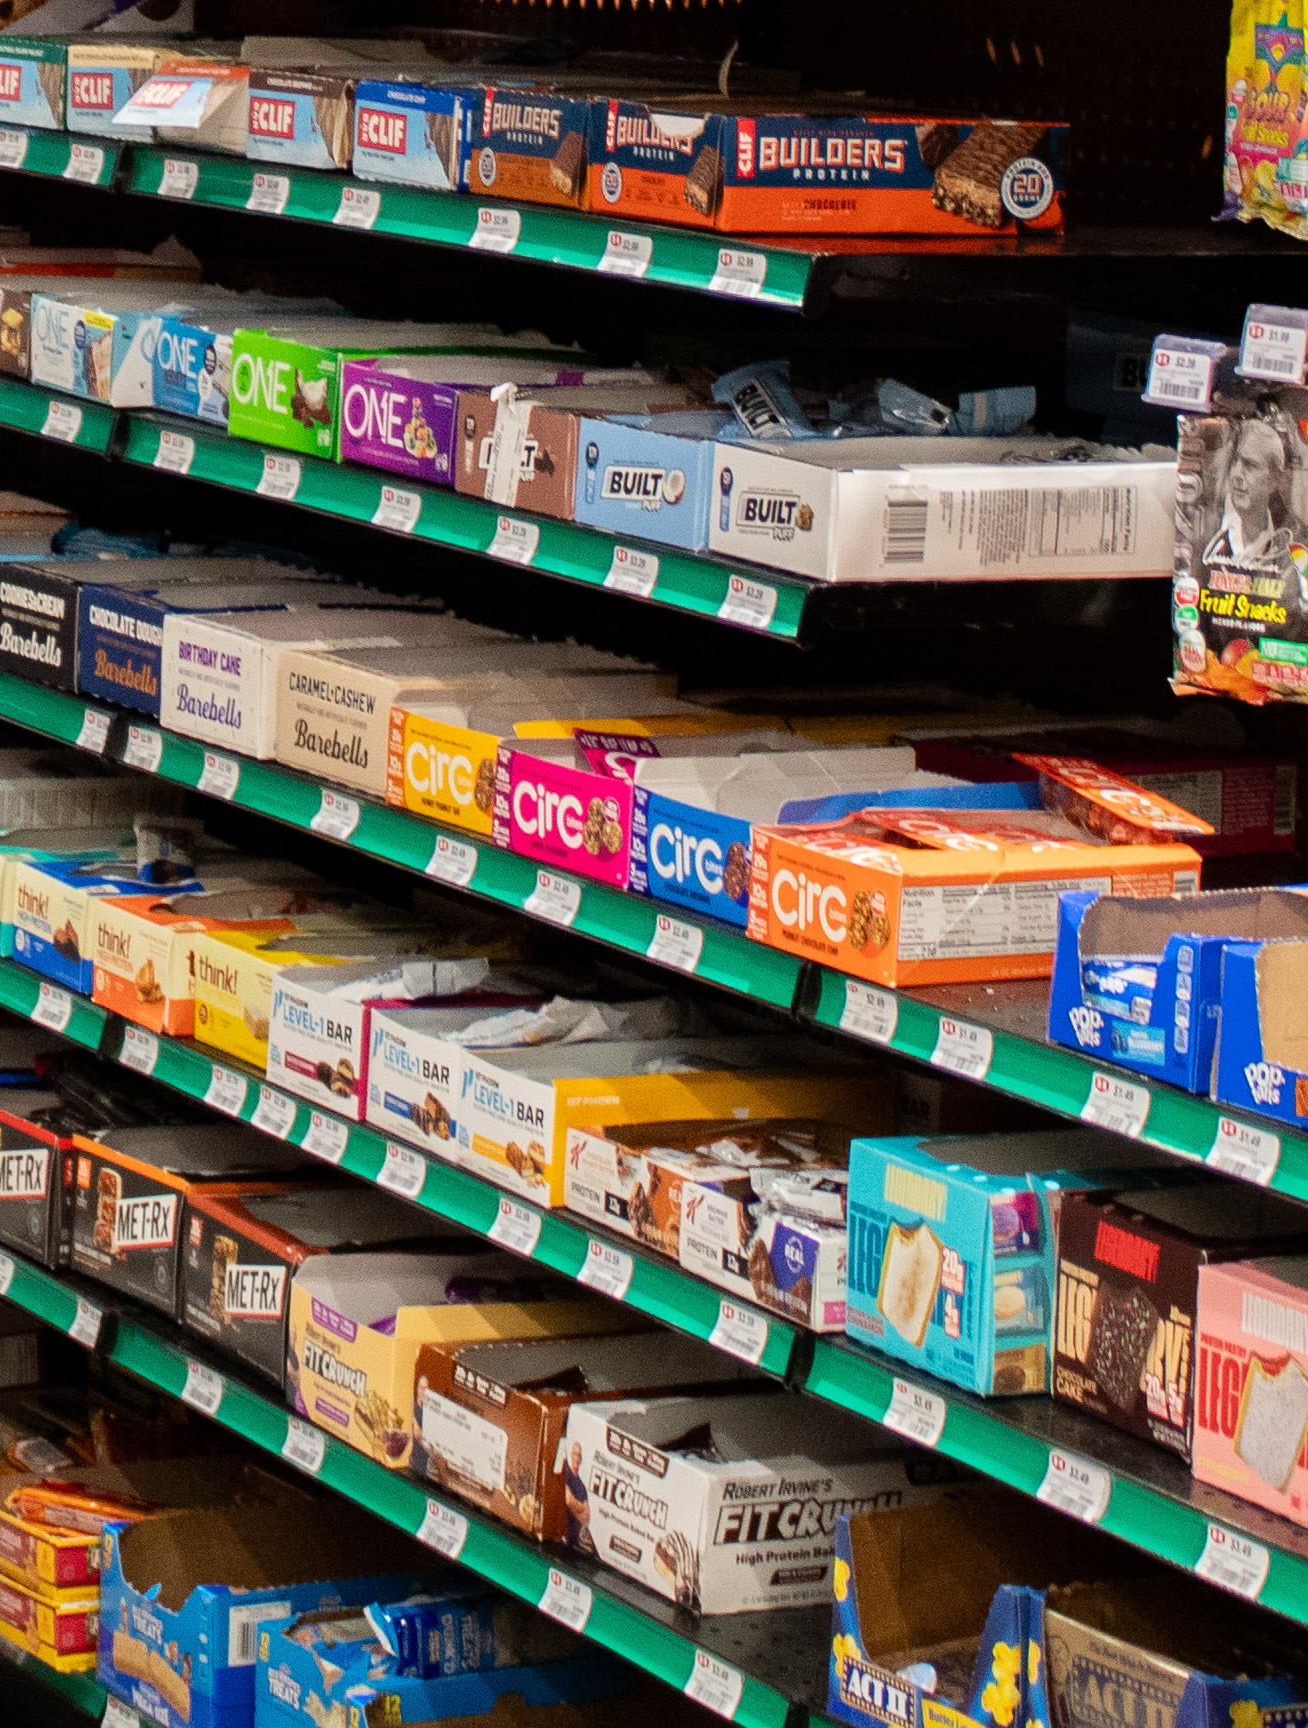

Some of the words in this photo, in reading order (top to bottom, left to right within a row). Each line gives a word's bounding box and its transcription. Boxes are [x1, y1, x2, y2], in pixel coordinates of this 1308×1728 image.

[82, 76, 114, 108] CLIF
[259, 99, 295, 137] CLIF
[368, 112, 406, 151] CLIF
[493, 102, 560, 140] BUILDERS
[633, 146, 675, 163] PROTEIN
[738, 132, 751, 174] CLIF
[759, 135, 905, 172] BUILDERS
[793, 168, 871, 181] PROTEIN
[1013, 176, 1041, 193] 20
[36, 300, 71, 349] ONE
[157, 331, 198, 373] ONE
[232, 351, 292, 414] ONE
[343, 383, 406, 448] ONE
[609, 470, 663, 496] BUILT
[744, 496, 797, 525] BUILT
[89, 604, 135, 636] CHOCOLATE
[1200, 589, 1234, 616] Fruit
[0, 621, 62, 668] Barebells
[178, 641, 219, 671] BIRTHDAY
[220, 652, 242, 676] CAKE
[94, 650, 158, 698] Barebells
[175, 683, 242, 730] Barebells
[294, 718, 369, 770] Barebells
[17, 884, 49, 921] think!
[97, 921, 131, 960] think!
[199, 955, 239, 996] think!
[282, 997, 326, 1035] LEVEL-1
[326, 1019, 352, 1045] BAR
[422, 1059, 451, 1086] BAR
[473, 1080, 515, 1115] LEVEL-1
[516, 1101, 545, 1129] BAR
[735, 1551, 764, 1566] High
[766, 1548, 812, 1563] Protein
[847, 1669, 882, 1703] ACT
